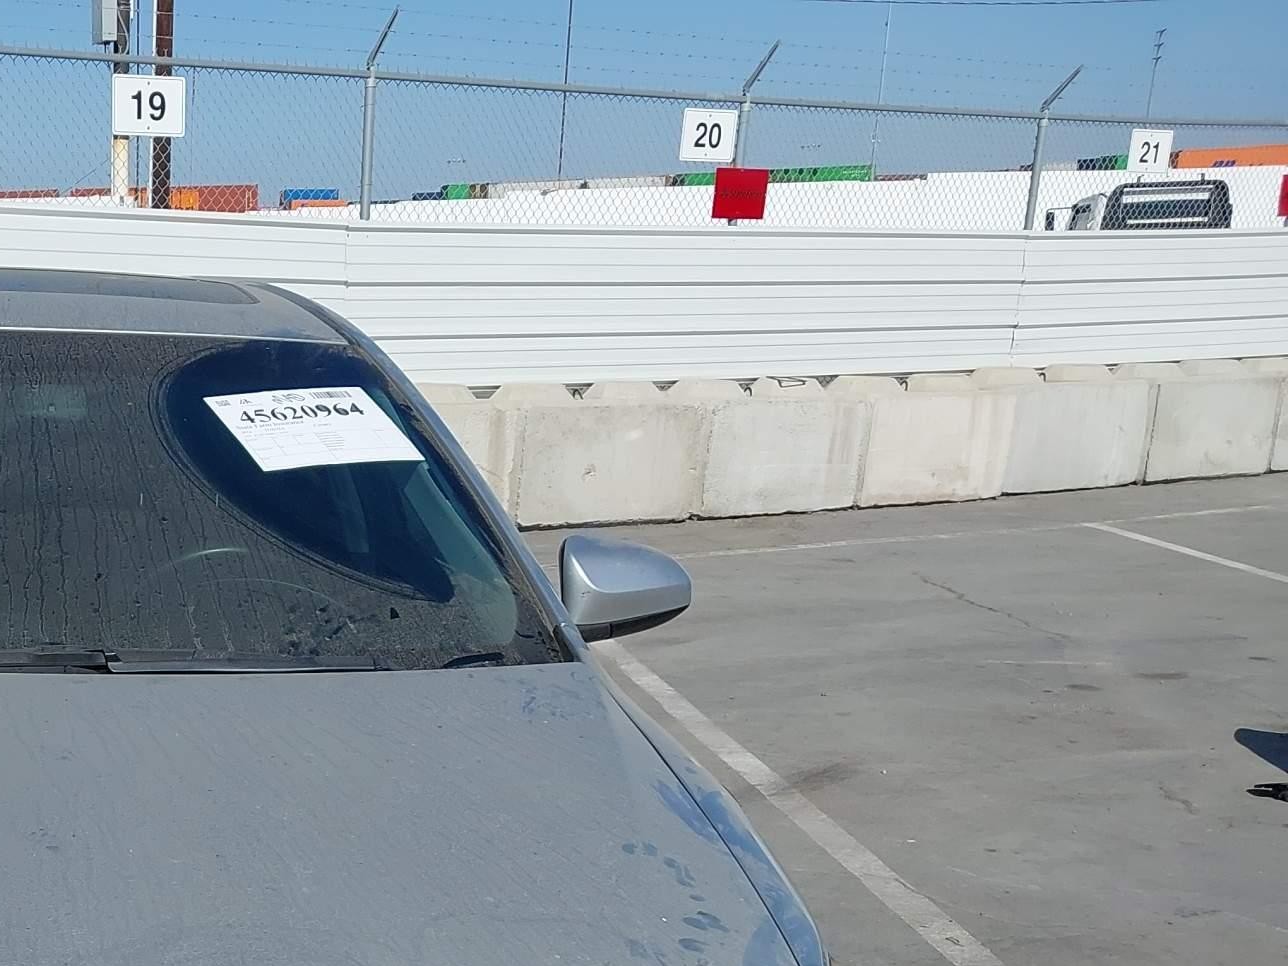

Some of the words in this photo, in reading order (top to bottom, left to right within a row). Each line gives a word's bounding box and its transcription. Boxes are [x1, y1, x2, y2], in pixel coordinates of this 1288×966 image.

[131, 91, 166, 121] 19
[693, 122, 723, 149] 20
[1138, 141, 1161, 164] 21
[240, 402, 365, 424] 45620964
